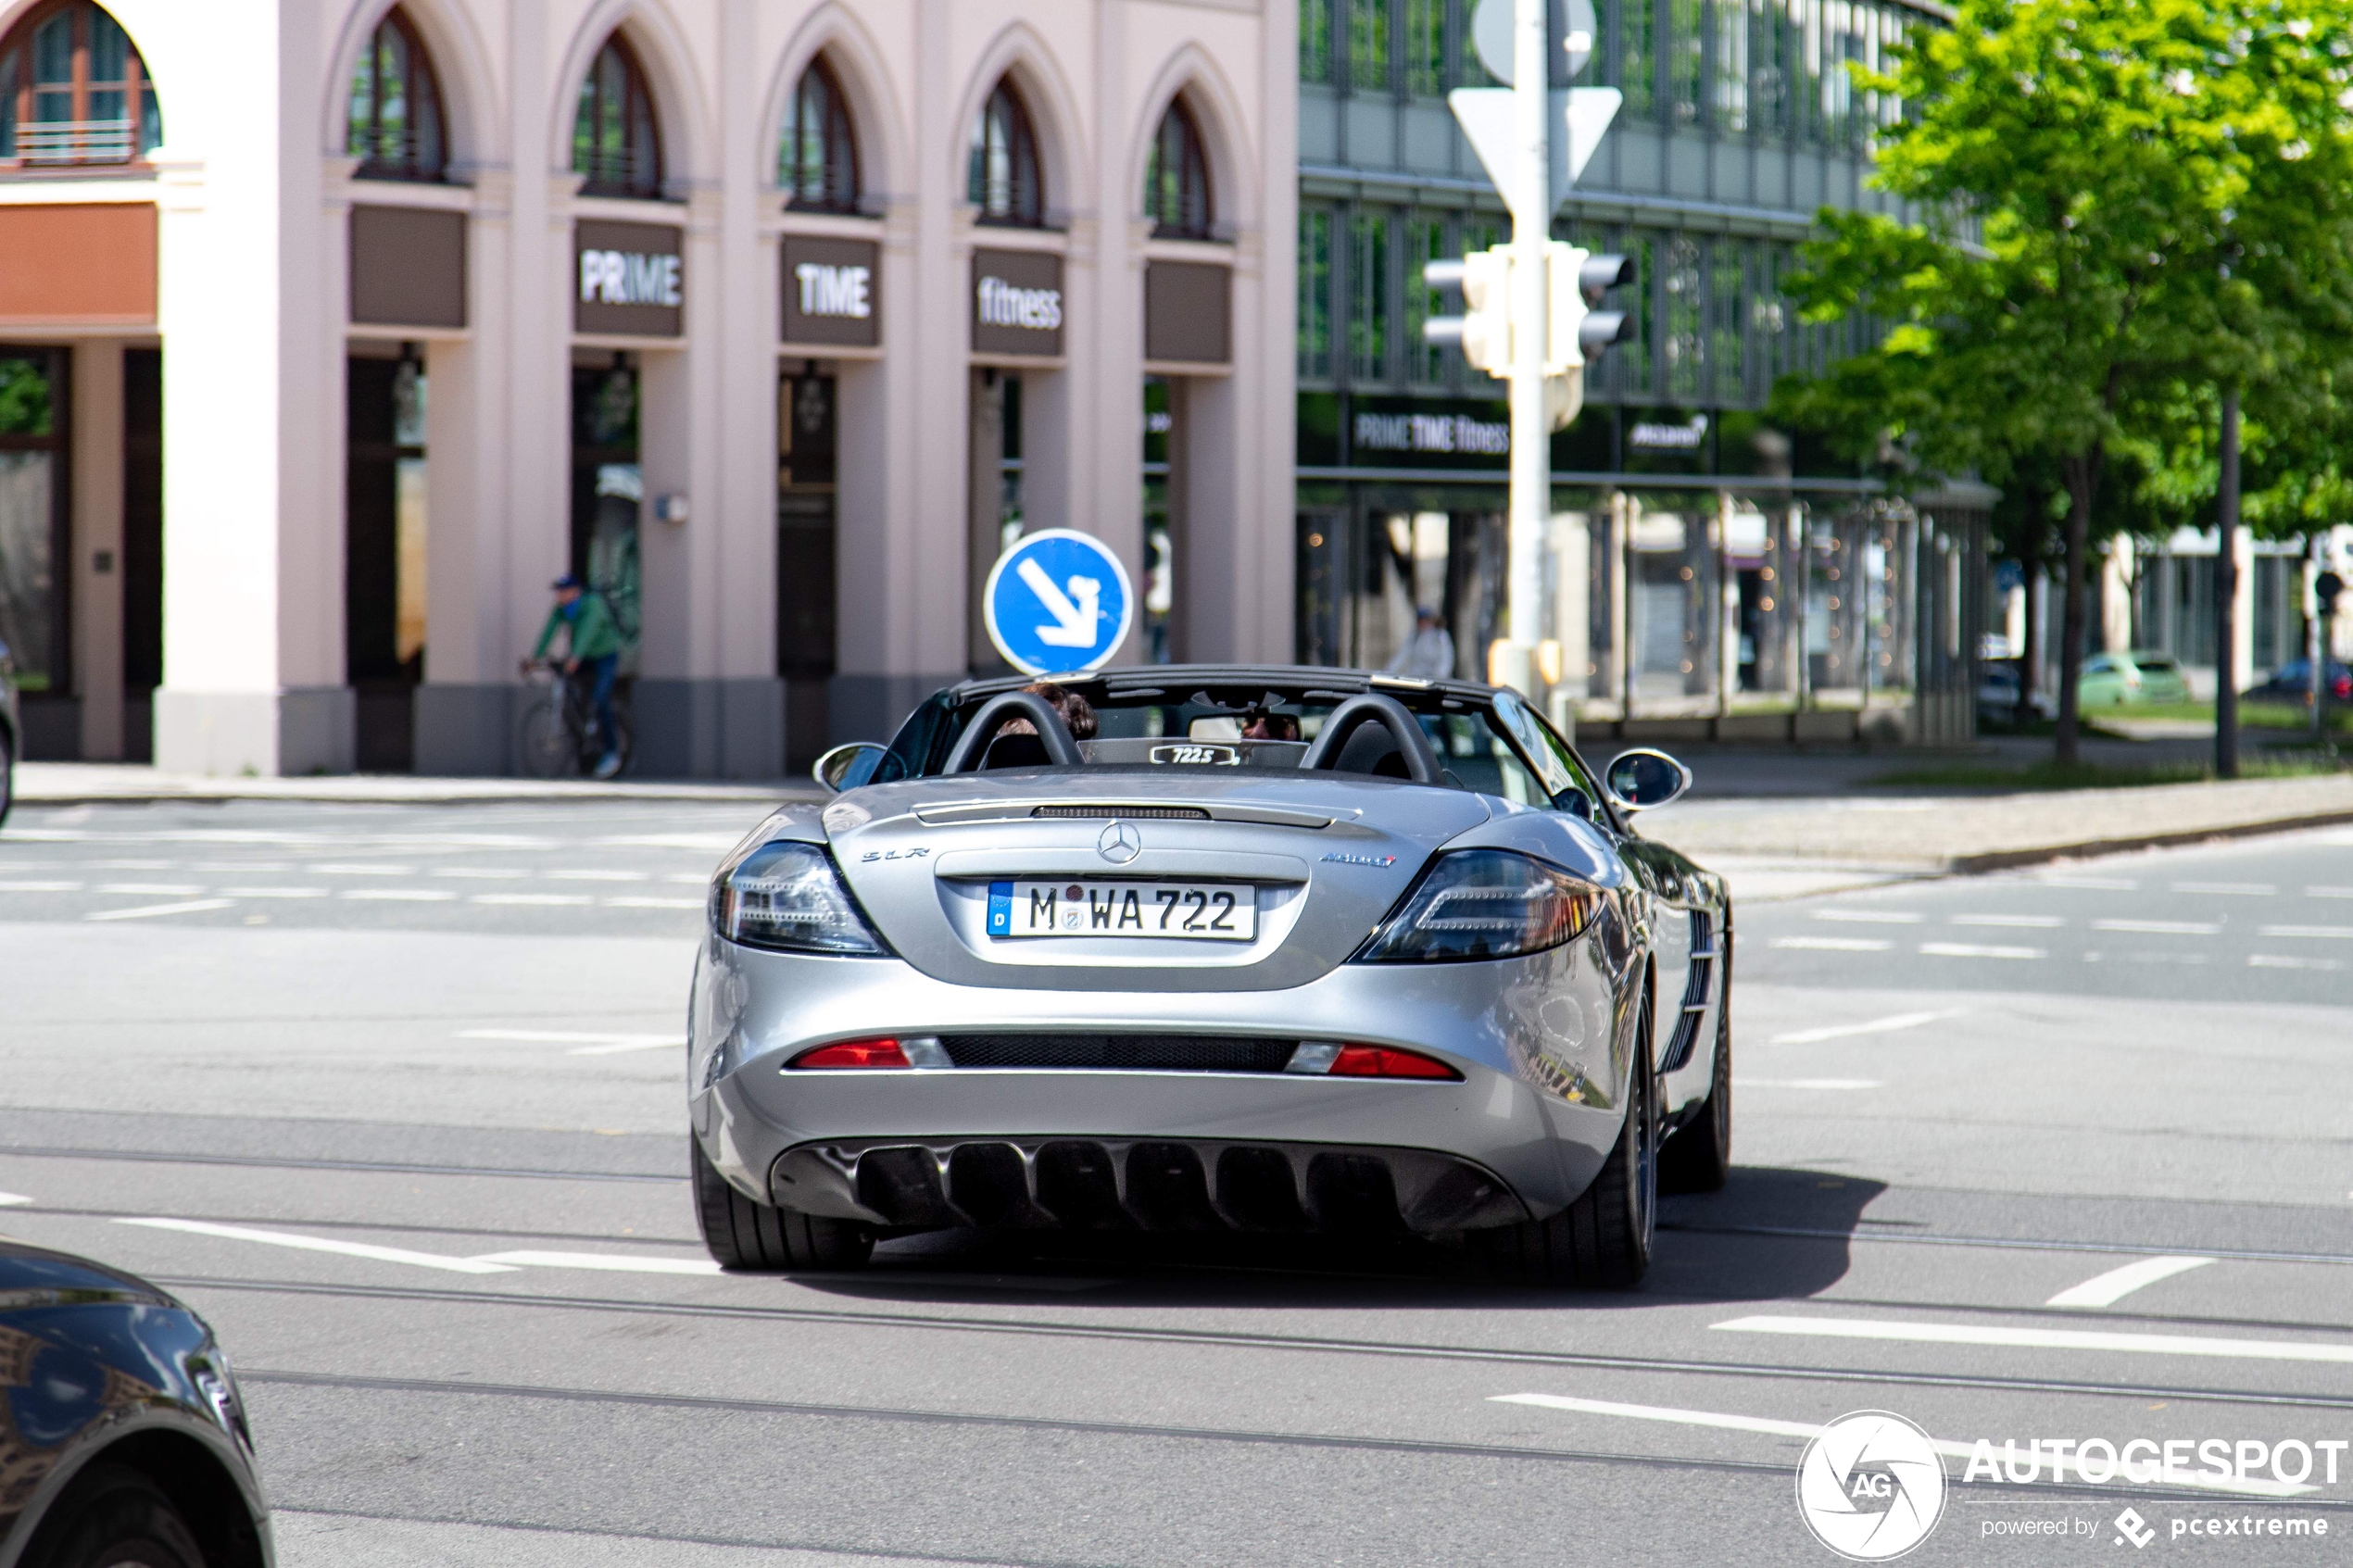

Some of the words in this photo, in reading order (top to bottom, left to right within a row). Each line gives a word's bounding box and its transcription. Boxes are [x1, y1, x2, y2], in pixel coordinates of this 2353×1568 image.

[580, 249, 681, 307] PRIME
[795, 262, 871, 319] TIME
[977, 276, 1062, 330] fitness
[1355, 414, 1409, 450] PRIME
[1412, 414, 1454, 452] TIME
[1455, 415, 1509, 454] fitness
[862, 847, 930, 862] SLR
[994, 913, 1004, 926] D
[1029, 888, 1056, 929] M
[1089, 889, 1143, 929] WA
[1156, 890, 1236, 931] 722
